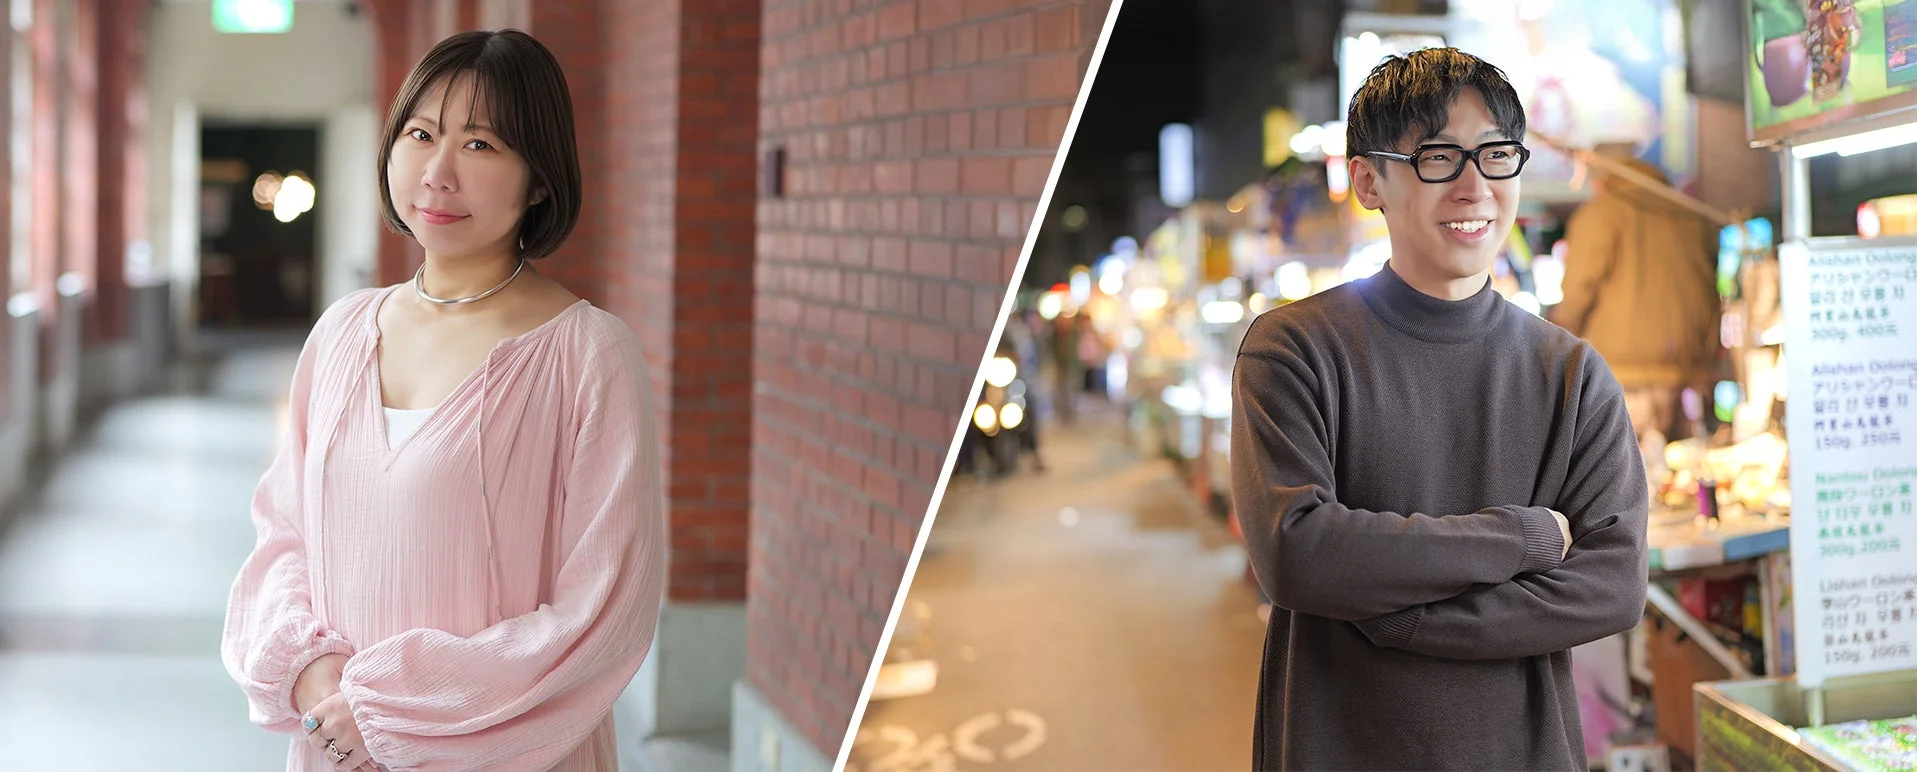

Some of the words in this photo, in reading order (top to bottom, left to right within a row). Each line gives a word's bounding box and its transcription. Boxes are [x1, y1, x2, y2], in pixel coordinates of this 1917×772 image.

[1809, 254, 1861, 266] Alishan
[1865, 251, 1916, 265] Oolong
[1812, 363, 1863, 376] Alishan
[1819, 577, 1867, 592] Lishan
